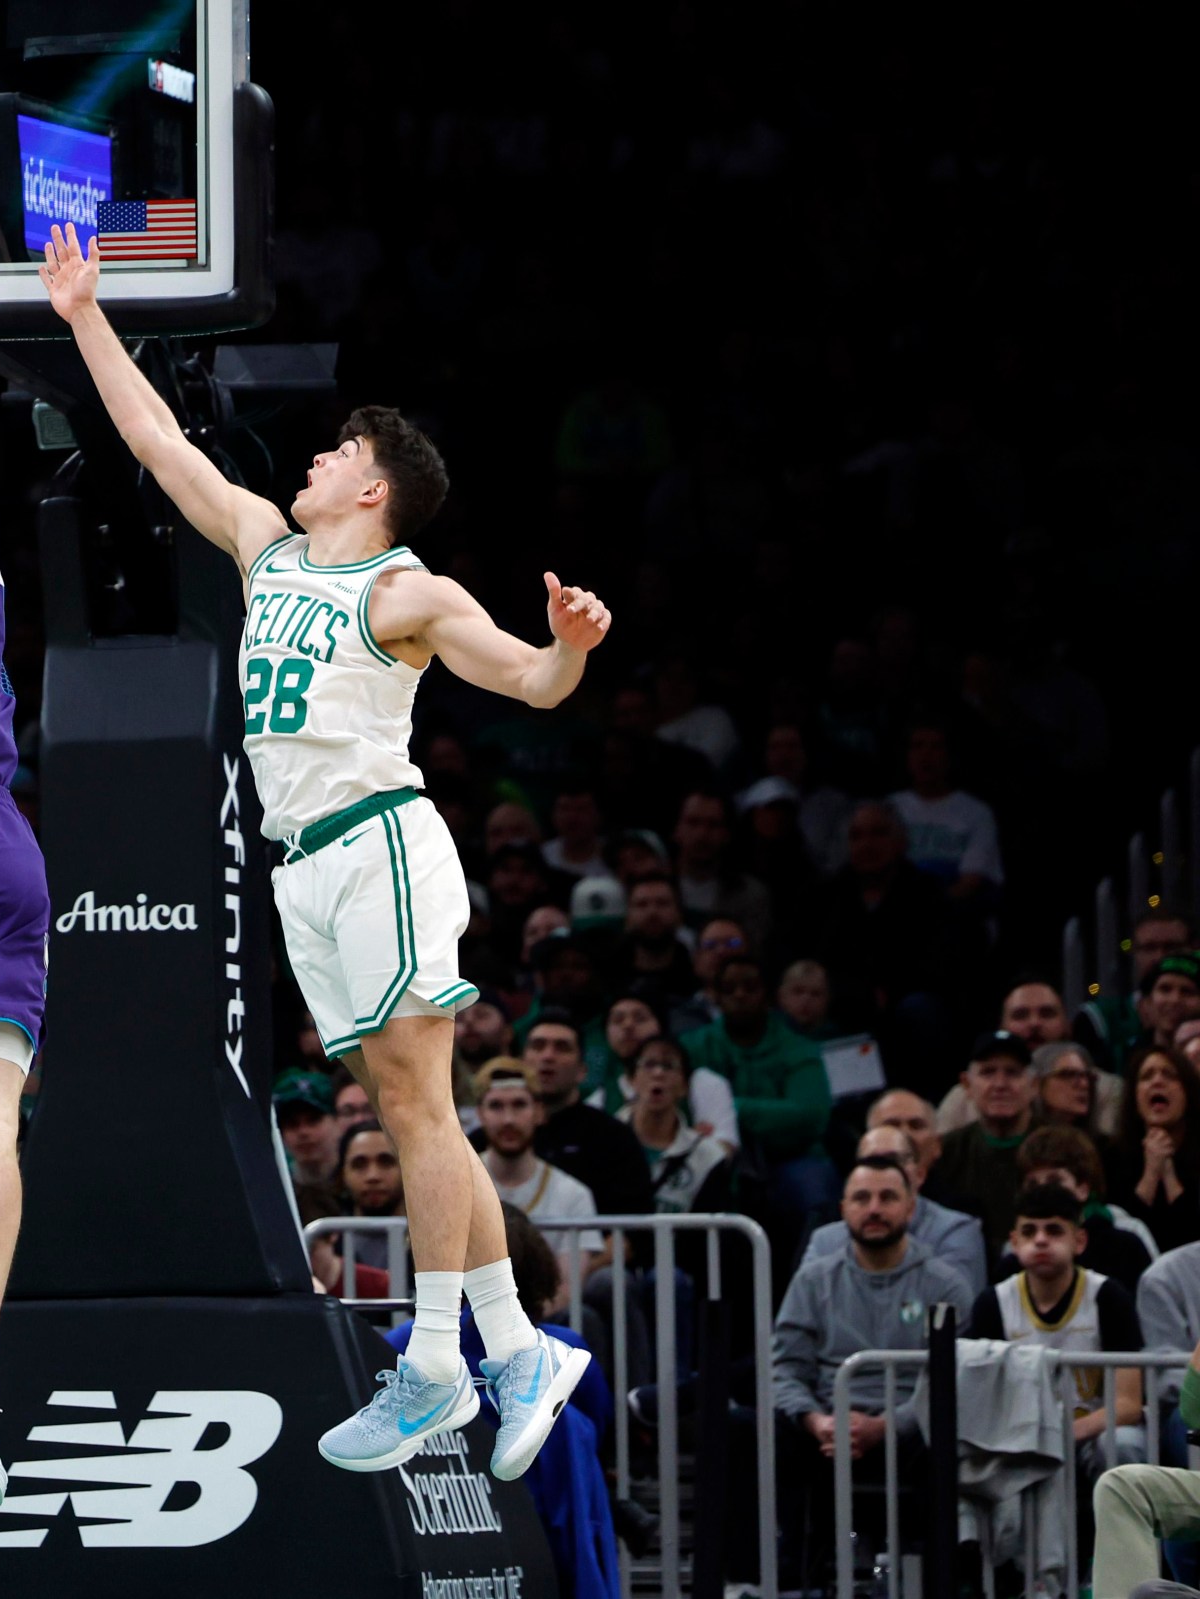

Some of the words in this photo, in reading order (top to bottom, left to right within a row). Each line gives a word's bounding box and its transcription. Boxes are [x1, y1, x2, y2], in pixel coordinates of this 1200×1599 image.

[245, 592, 350, 664] CELTICS
[244, 657, 315, 735] 28
[55, 890, 199, 933] Amica
[220, 752, 252, 1100] xfinity
